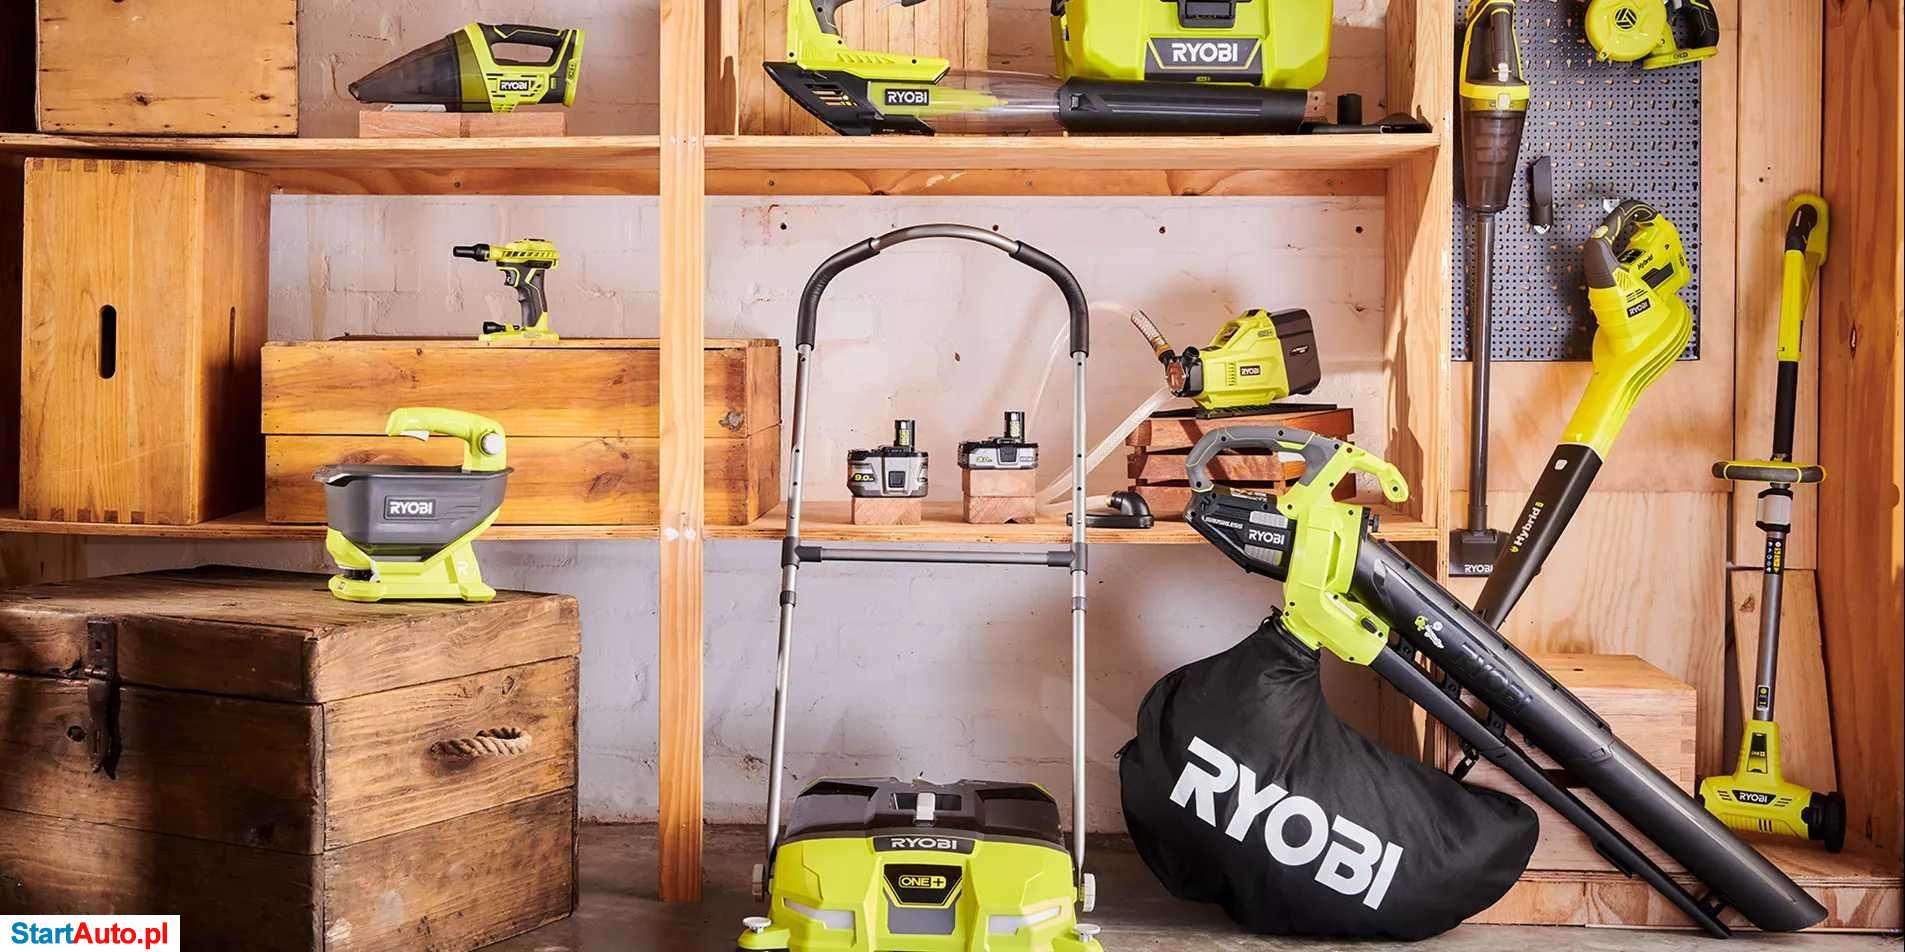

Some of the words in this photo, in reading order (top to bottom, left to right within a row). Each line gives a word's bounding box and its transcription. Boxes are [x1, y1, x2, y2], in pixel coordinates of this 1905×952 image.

[1171, 42, 1239, 63] RYOBI
[500, 81, 528, 91] RYOBI
[887, 91, 928, 104] RYOBI
[389, 501, 433, 515] RYOBI
[1513, 507, 1541, 547] Hybrid
[1248, 529, 1285, 545] RYOBI
[1739, 791, 1768, 804] RYOBI
[1169, 736, 1404, 911] RYOBI
[890, 837, 958, 850] RYOBI
